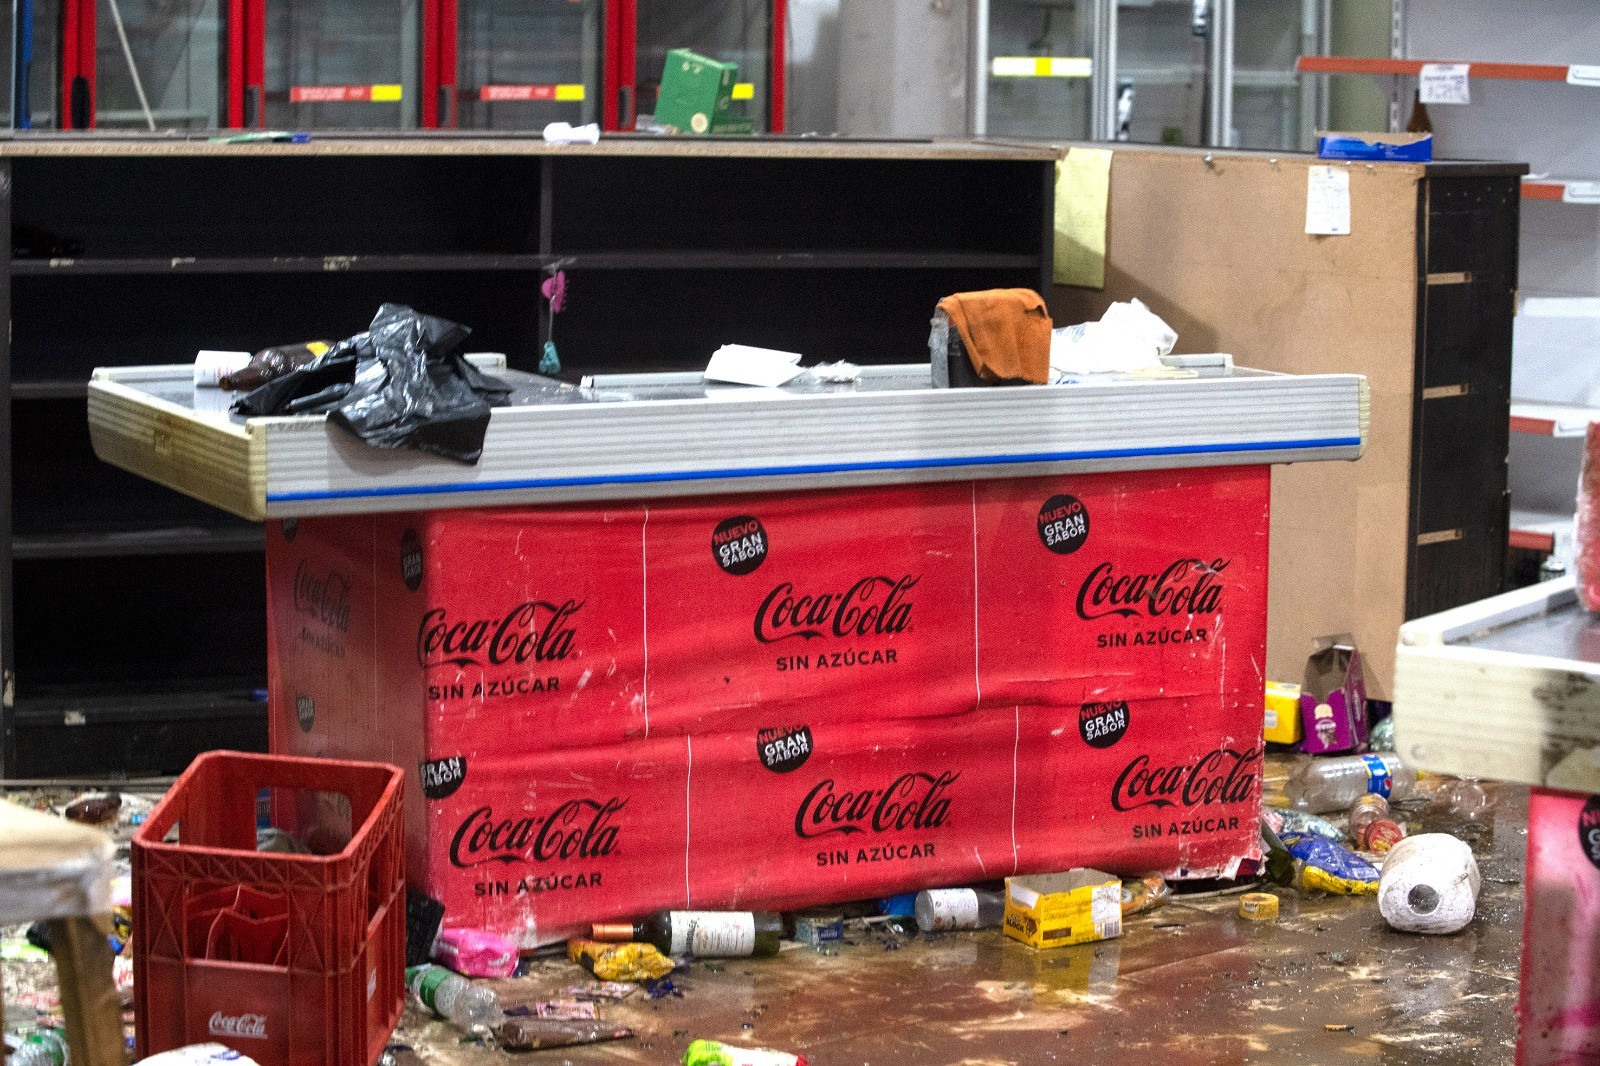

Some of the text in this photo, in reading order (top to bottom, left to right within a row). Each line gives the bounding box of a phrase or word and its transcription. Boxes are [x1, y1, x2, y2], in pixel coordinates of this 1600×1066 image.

[1038, 502, 1082, 524] NUEVO
[714, 520, 759, 545] NUEVO
[1044, 513, 1085, 538] GRAN
[1046, 524, 1087, 546] SABOR
[719, 532, 762, 558] GRAN
[722, 543, 765, 567] SABOR
[1076, 557, 1233, 621] Coca-Cola
[754, 573, 923, 643] Coca-Cola
[416, 597, 587, 669] Coca-Cola
[1097, 626, 1208, 648] SIN AZÚCAR
[776, 649, 898, 671] SIN AZÚCAR
[428, 676, 560, 700] SIN AZÚCAR
[1085, 708, 1125, 732] GRAN
[1086, 719, 1126, 741] SABOR
[765, 731, 806, 757] GRAN
[767, 742, 809, 766] SABOR
[1111, 748, 1264, 812] Coca-Cola
[794, 770, 962, 839] Coca-Cola
[449, 796, 631, 869] Coca-Cola
[1132, 816, 1239, 838] SIN AZÚCAR
[817, 843, 935, 866] SIN AZÚCAR
[474, 872, 603, 897] SIN AZÚCAR
